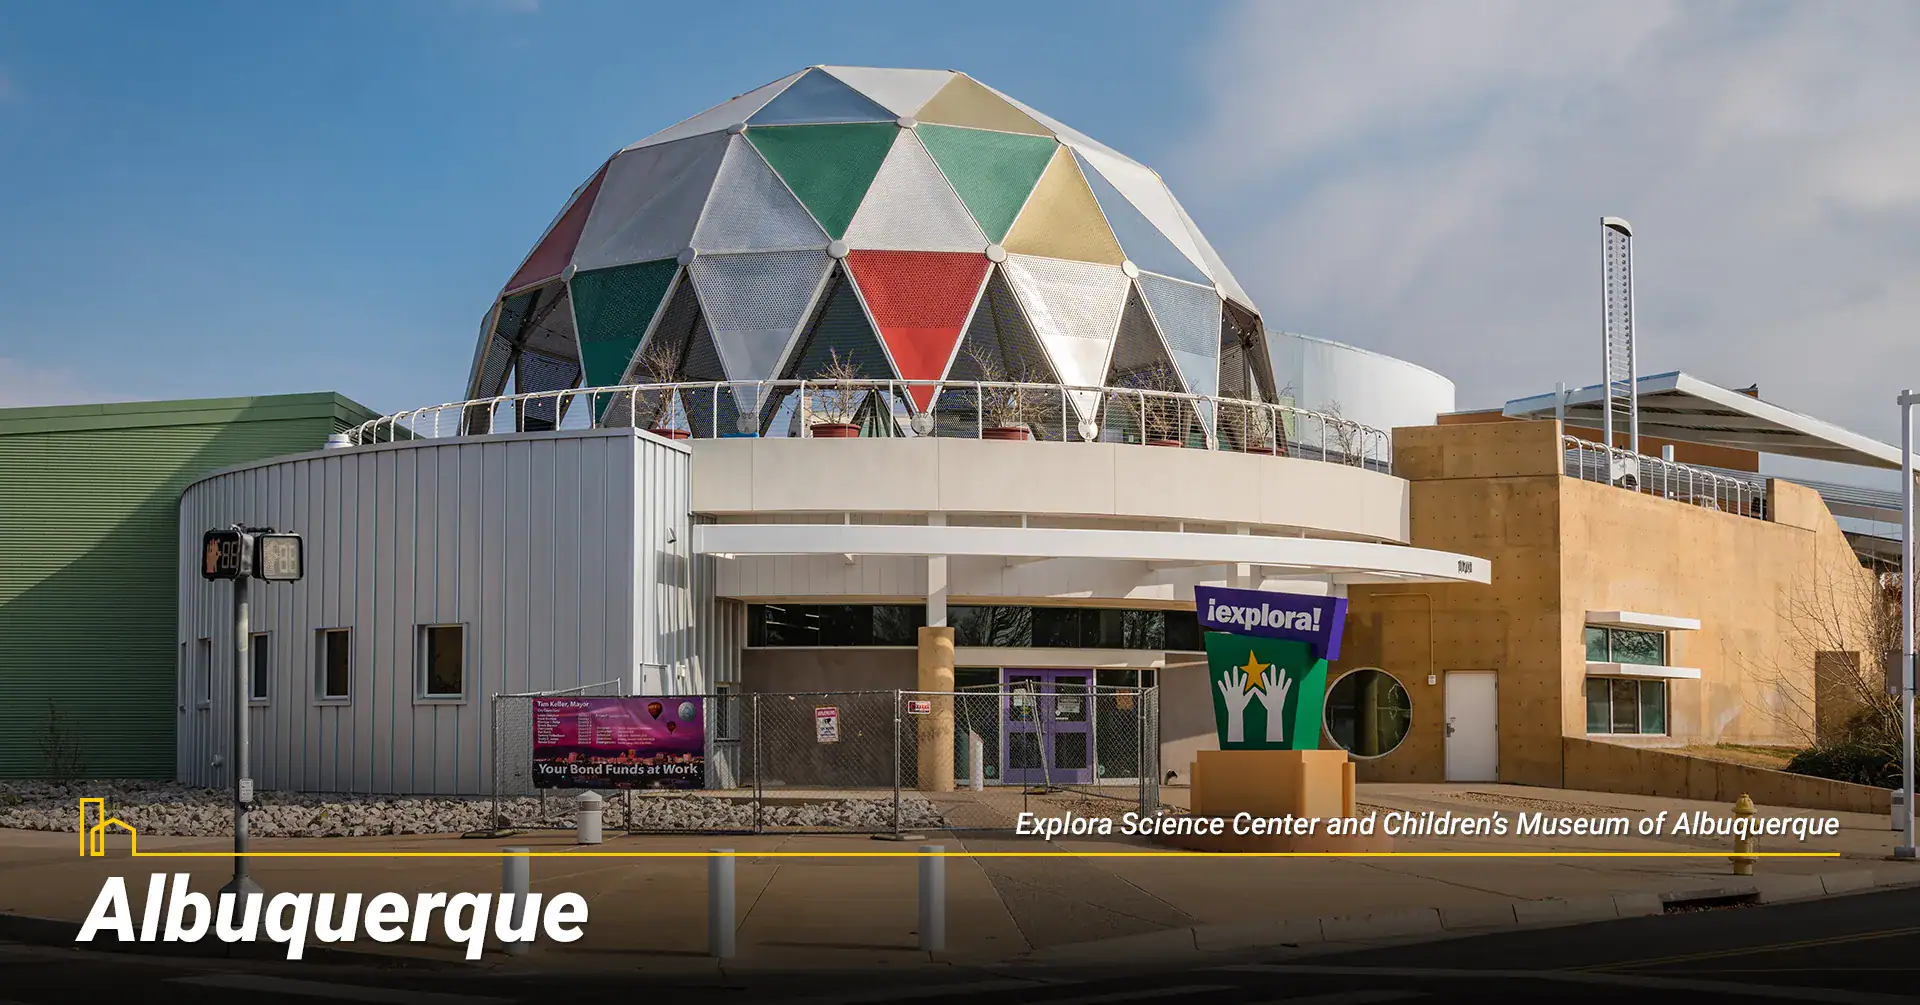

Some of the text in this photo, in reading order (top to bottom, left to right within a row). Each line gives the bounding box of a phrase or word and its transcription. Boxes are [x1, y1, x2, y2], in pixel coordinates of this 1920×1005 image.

[549, 701, 569, 709] Keller,
[570, 701, 589, 709] Mayor
[538, 763, 698, 775] Your Bond Funds at Work
